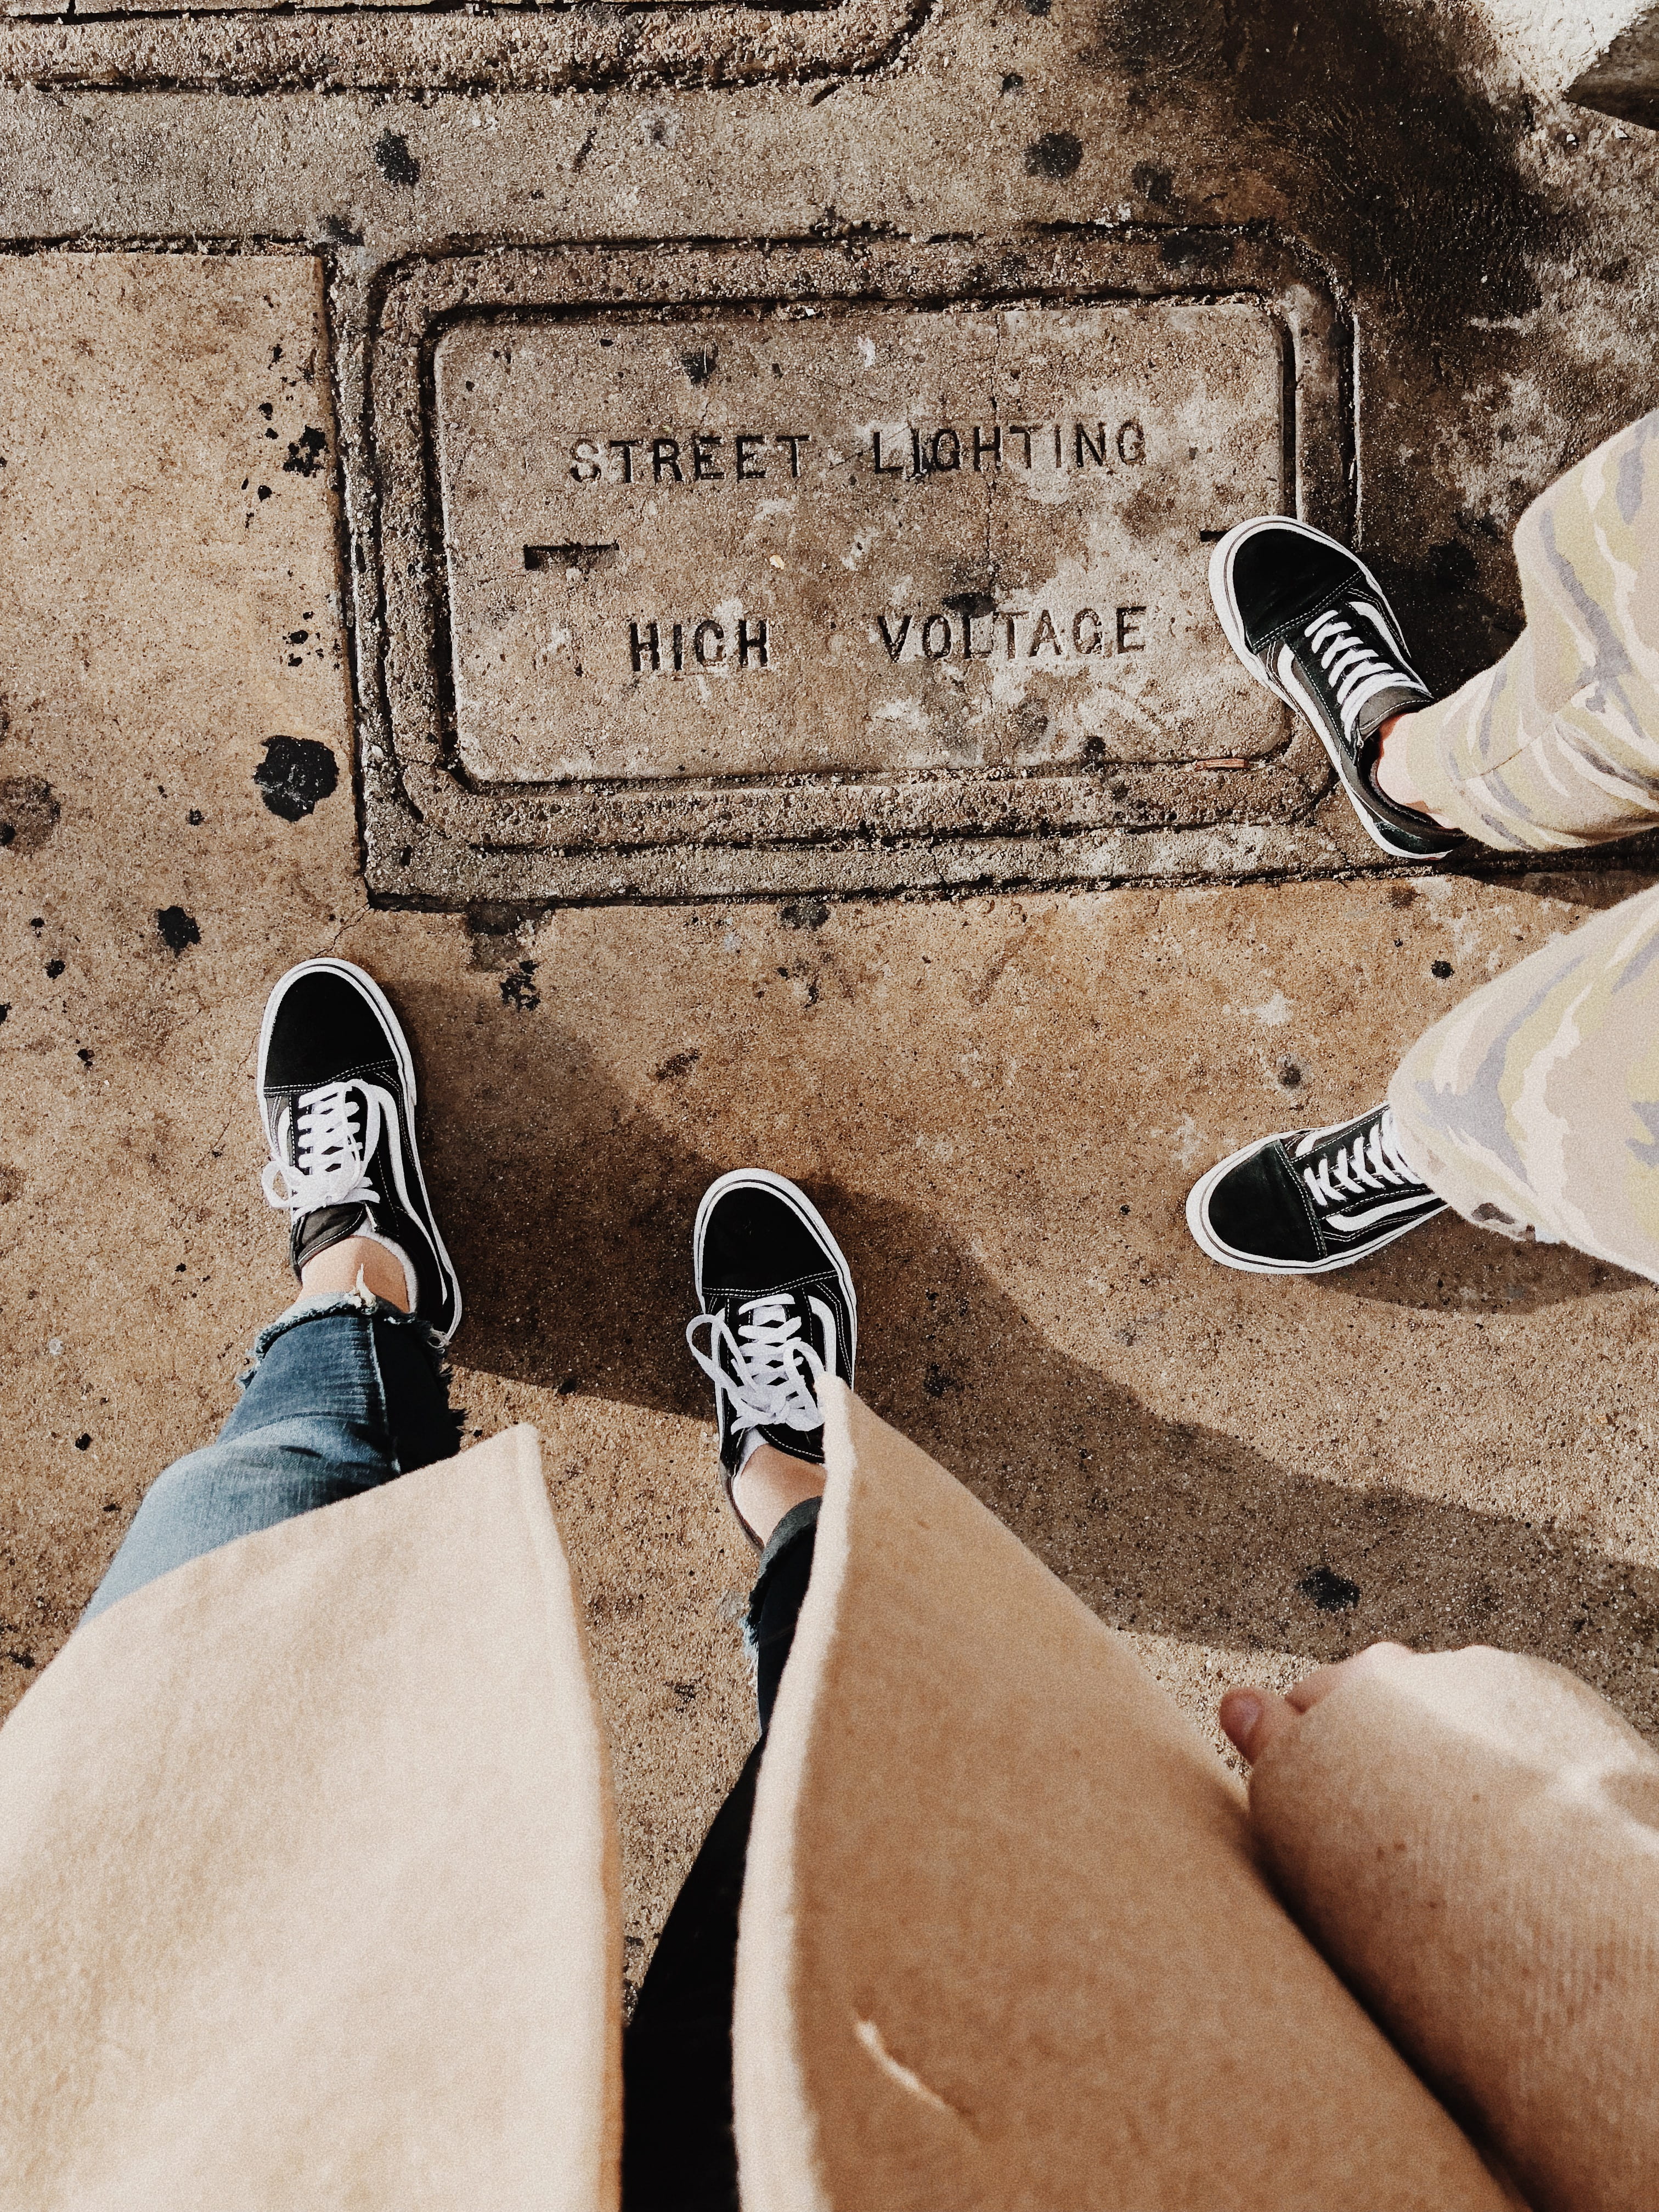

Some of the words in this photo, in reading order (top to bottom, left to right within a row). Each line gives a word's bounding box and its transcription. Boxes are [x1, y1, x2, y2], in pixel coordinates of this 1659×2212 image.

[571, 435, 811, 483] STREET
[874, 420, 1146, 477] LIGHTING
[629, 620, 768, 672] HIGH
[878, 606, 1147, 662] VOLTAGE
